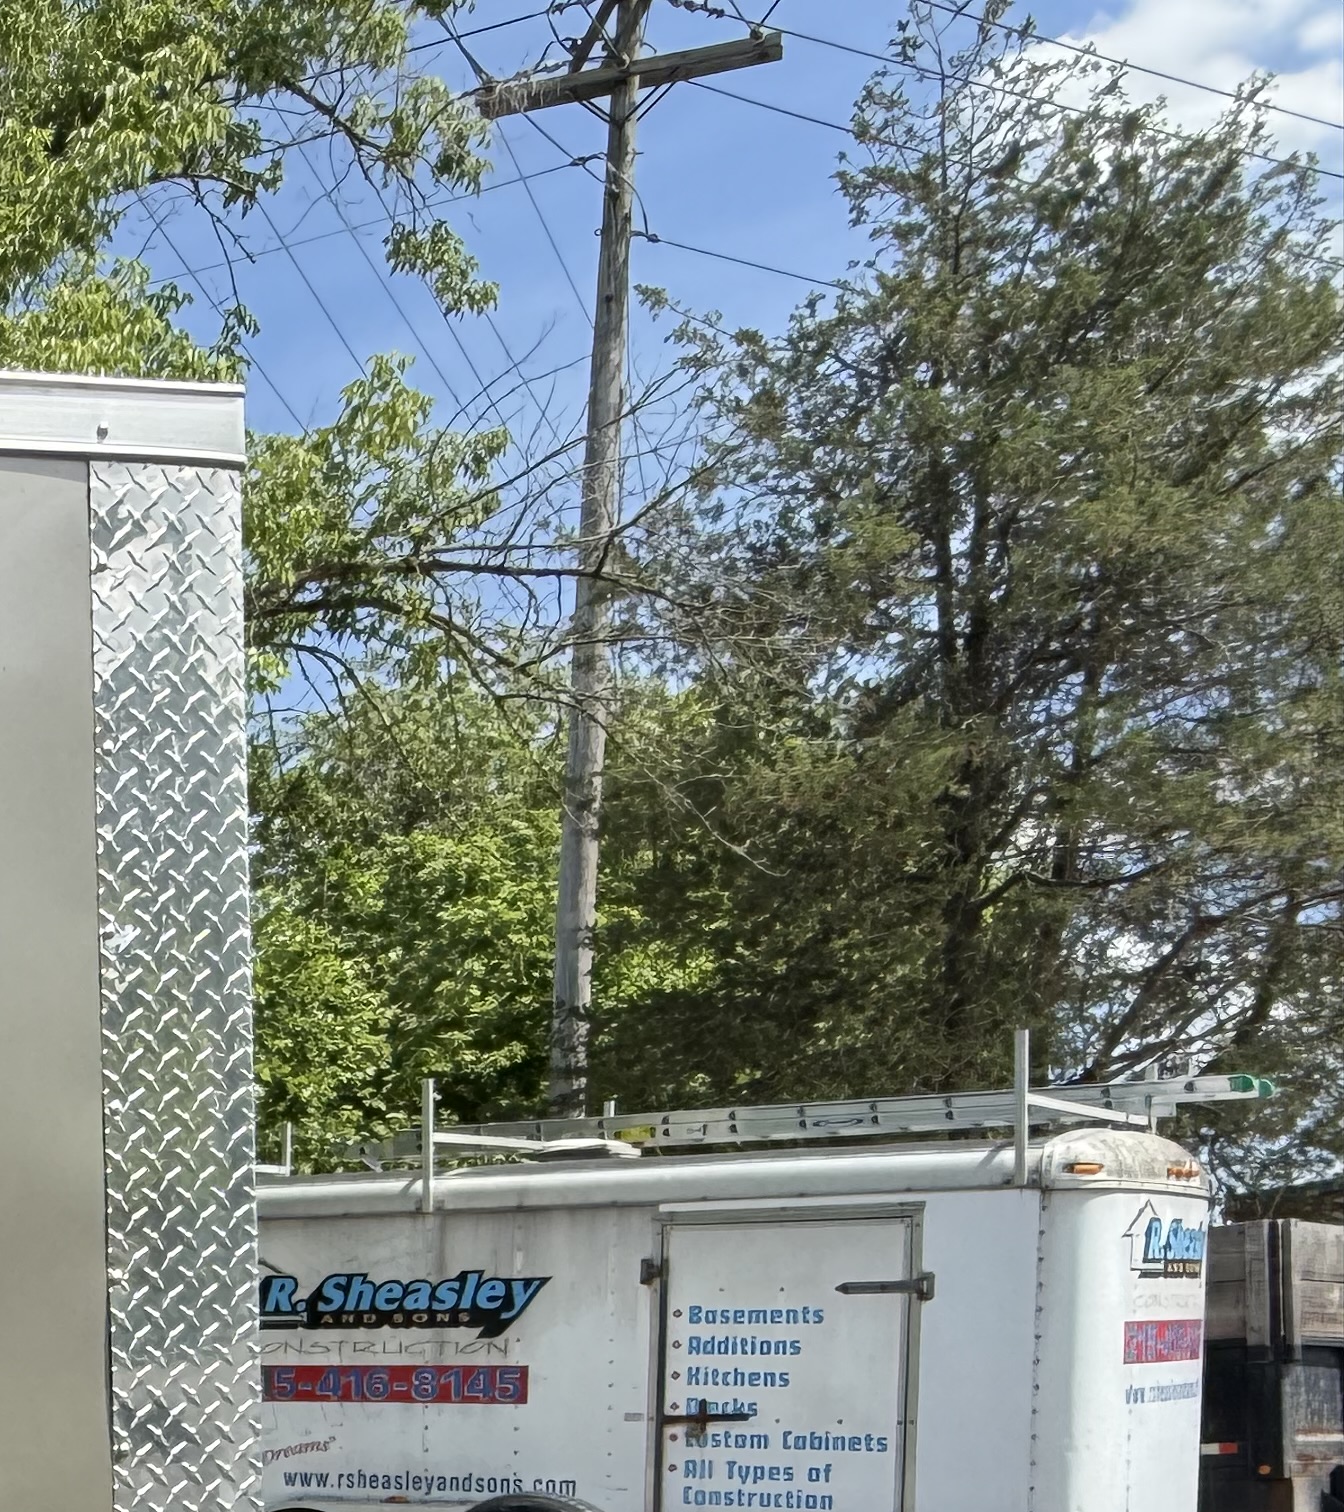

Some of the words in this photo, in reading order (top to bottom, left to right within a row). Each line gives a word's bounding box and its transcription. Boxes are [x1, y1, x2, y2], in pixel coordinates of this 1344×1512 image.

[264, 1277, 307, 1312] R.
[316, 1271, 543, 1320] Sheasley
[320, 1313, 377, 1324] AND
[392, 1313, 471, 1324] SONS
[688, 1304, 825, 1326] Basements
[261, 1338, 510, 1362] ONSTRUCTION
[687, 1335, 802, 1357] Additions
[273, 1366, 522, 1401] 5-416-8145
[685, 1365, 791, 1388] Kitchens
[782, 1431, 888, 1453] Cabinets
[283, 1469, 577, 1497] www.rsheasleyandsonscom
[683, 1459, 713, 1480] All
[726, 1460, 794, 1485] Types
[807, 1463, 832, 1483] of
[682, 1486, 833, 1511] Construction
